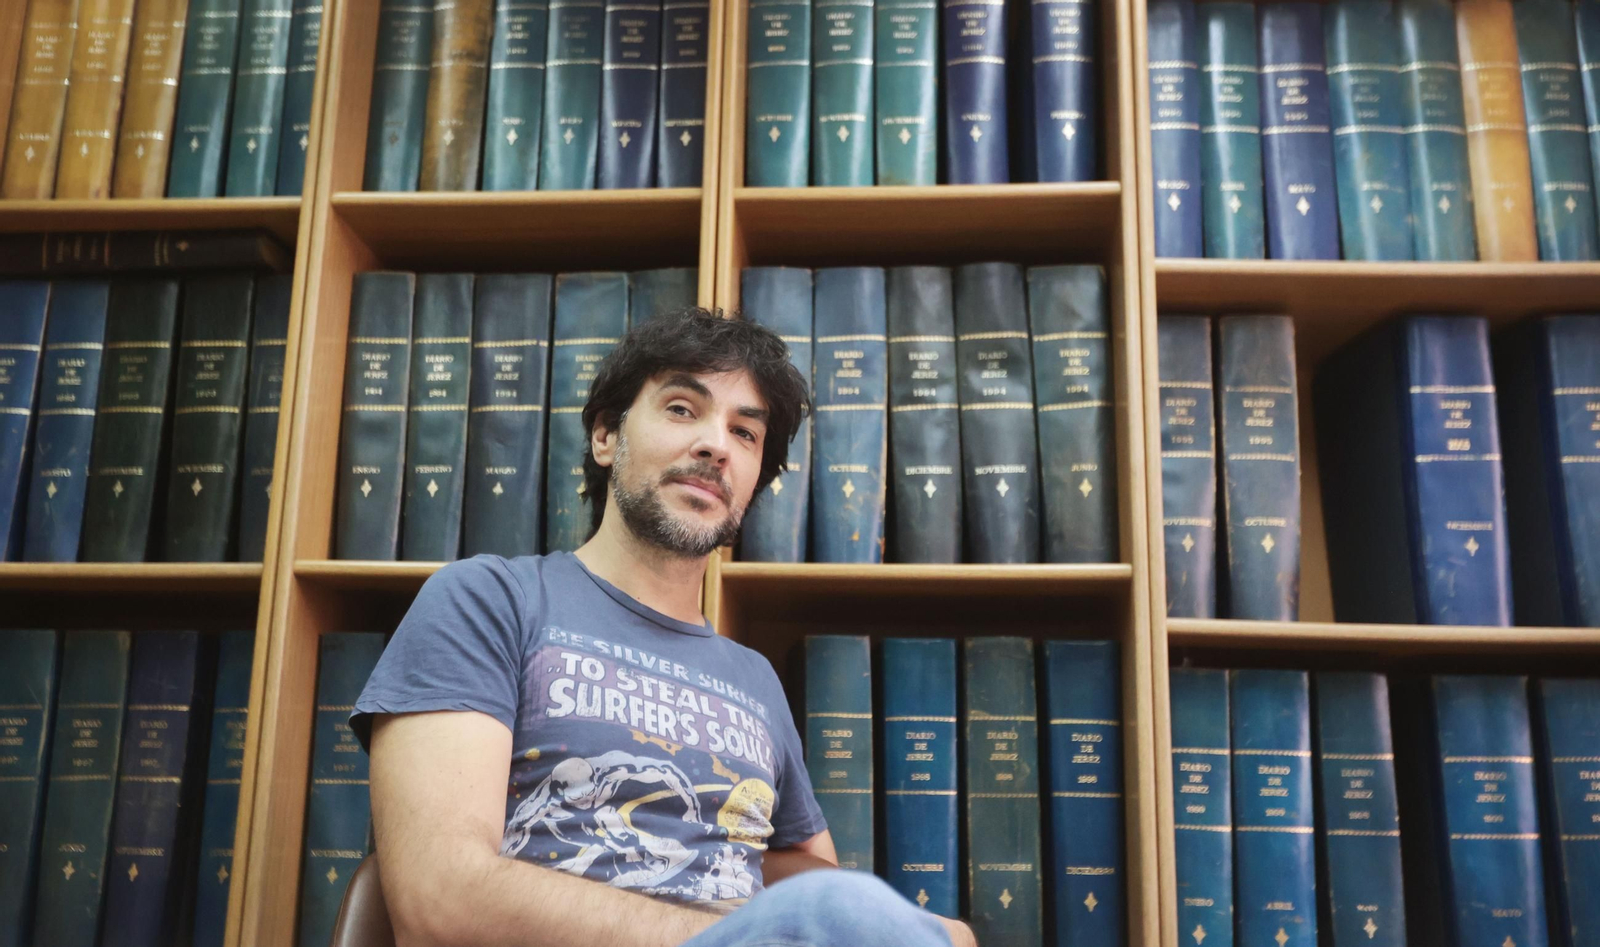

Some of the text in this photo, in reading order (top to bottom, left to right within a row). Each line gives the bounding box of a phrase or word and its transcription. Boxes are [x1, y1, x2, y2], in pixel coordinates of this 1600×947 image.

[834, 351, 864, 359] DIARIO
[908, 351, 939, 360] DIARIO
[978, 351, 1008, 360] DIARIO
[1059, 348, 1090, 358] DIARIO
[425, 354, 454, 363] DIARIO
[494, 354, 522, 362] DIARIO
[494, 372, 519, 380] JEREZ
[836, 369, 862, 378] JEREZ
[911, 370, 938, 379] JEREZ
[981, 370, 1008, 379] JEREZ
[1063, 367, 1090, 376] JEREZ
[427, 372, 452, 381] JEREZ
[983, 387, 1007, 396] 1994
[1065, 384, 1089, 394] 1994
[1166, 398, 1197, 407] DIARIO
[1242, 398, 1275, 408] DIARIO
[1168, 417, 1195, 426] JEREZ
[1245, 417, 1273, 427] JEREZ
[415, 464, 453, 473] FEBRERO
[828, 464, 869, 473] OCTUBRE
[905, 466, 952, 475] DICIEMBRE
[975, 463, 1027, 475] NOVIEMBRE
[1072, 463, 1098, 472] JUNIO
[1244, 516, 1287, 527] OCTUBRE
[593, 640, 690, 681] SILVER
[616, 667, 718, 719] STEAL
[722, 702, 765, 741] THE
[546, 678, 772, 773] SURFER'S SOUL!
[822, 729, 853, 738] DIARIO
[906, 732, 936, 740] DIARIO
[986, 731, 1019, 740] DIARIO
[1071, 733, 1103, 742] DIARIO
[829, 740, 843, 749] DE
[914, 742, 928, 751] DE
[994, 742, 1008, 751] DE
[1080, 744, 1094, 753] DE
[824, 751, 853, 759] JEREZ
[905, 753, 934, 761] JEREZ
[990, 753, 1019, 761] JEREZ
[1071, 755, 1101, 764] JEREZ
[1180, 762, 1212, 773] DIARIO
[1258, 765, 1291, 776] DIARIO
[1341, 768, 1375, 778] DIARIO
[1474, 771, 1506, 780] DIARIO
[1180, 784, 1210, 794] JEREZ
[1259, 788, 1289, 797] JEREZ
[1476, 794, 1506, 803] JEREZ
[311, 849, 363, 859] NOVIEMBRE
[902, 863, 945, 872] OCTUBRE
[979, 863, 1033, 872] NOVIEMBRE
